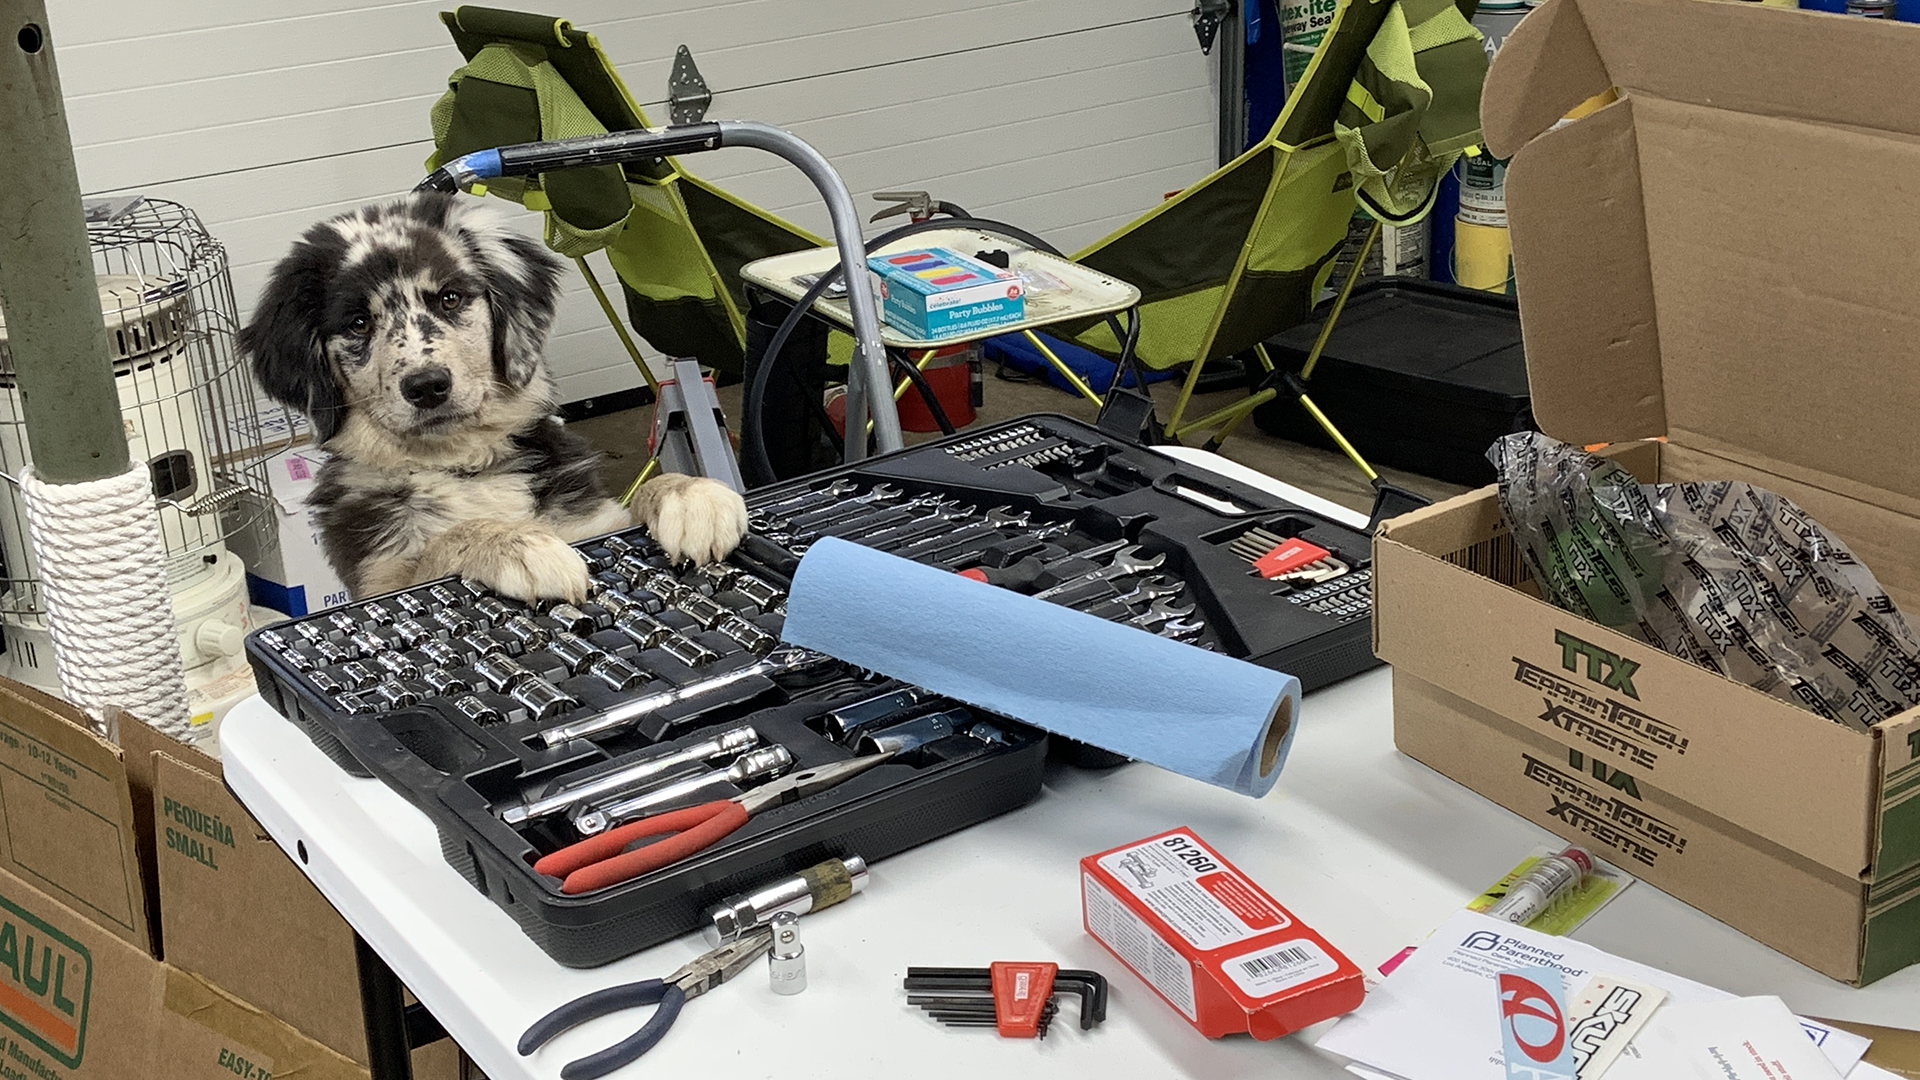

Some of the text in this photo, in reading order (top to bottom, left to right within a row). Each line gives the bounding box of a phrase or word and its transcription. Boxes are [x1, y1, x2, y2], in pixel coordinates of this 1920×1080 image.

[949, 302, 1004, 320] Party Bubbles
[1568, 540, 1598, 588] TTX
[1766, 535, 1804, 586] TTX
[1731, 569, 1767, 622] TTX
[1696, 603, 1735, 657] TTX
[1555, 628, 1641, 702] TTX
[1537, 697, 1659, 771] XTREME
[28, 743, 52, 766] 10-12
[53, 757, 78, 780] Years
[163, 795, 236, 849] PEQUEÑA
[1545, 792, 1659, 868] XTREME
[165, 826, 219, 871] SMALL
[1162, 836, 1219, 874] 81260
[1453, 950, 1482, 961] Planned
[1496, 944, 1585, 977] Parenthood
[1503, 937, 1565, 961] Planned
